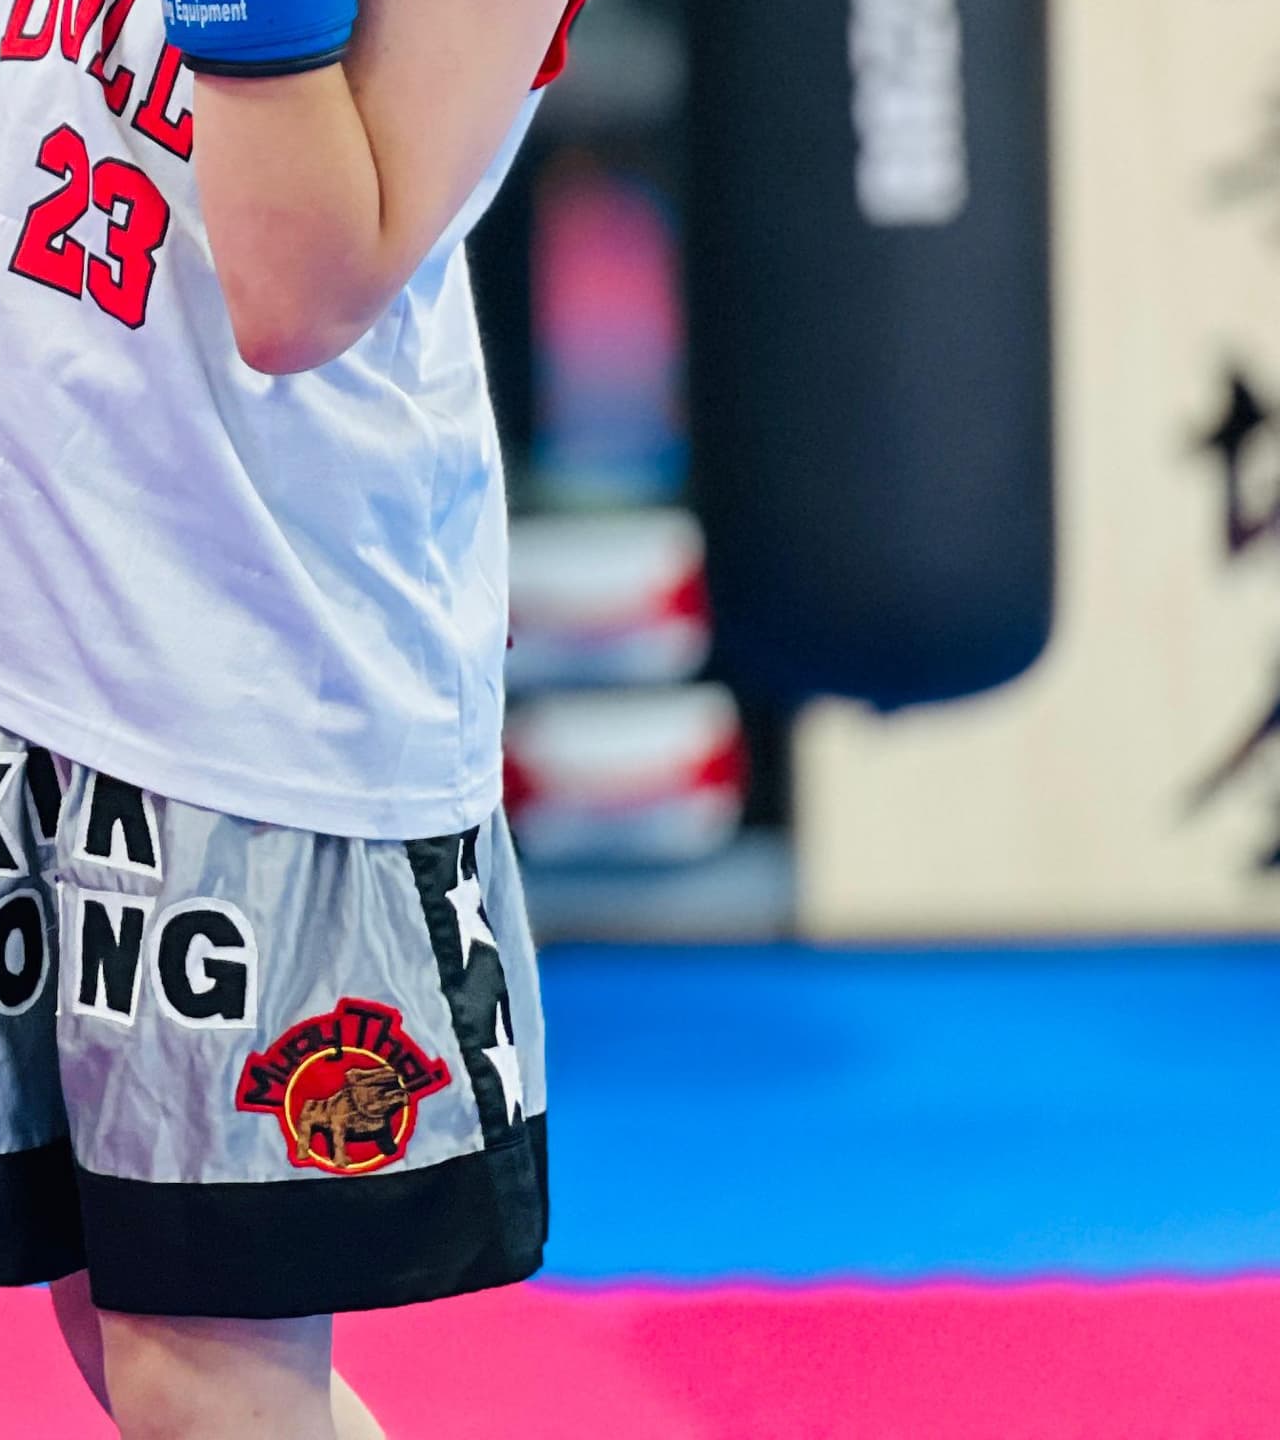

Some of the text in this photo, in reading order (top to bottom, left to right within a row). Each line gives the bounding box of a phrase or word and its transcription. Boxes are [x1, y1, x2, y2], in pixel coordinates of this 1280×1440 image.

[7, 121, 171, 330] 23
[243, 1007, 444, 1108] Muay Thai
